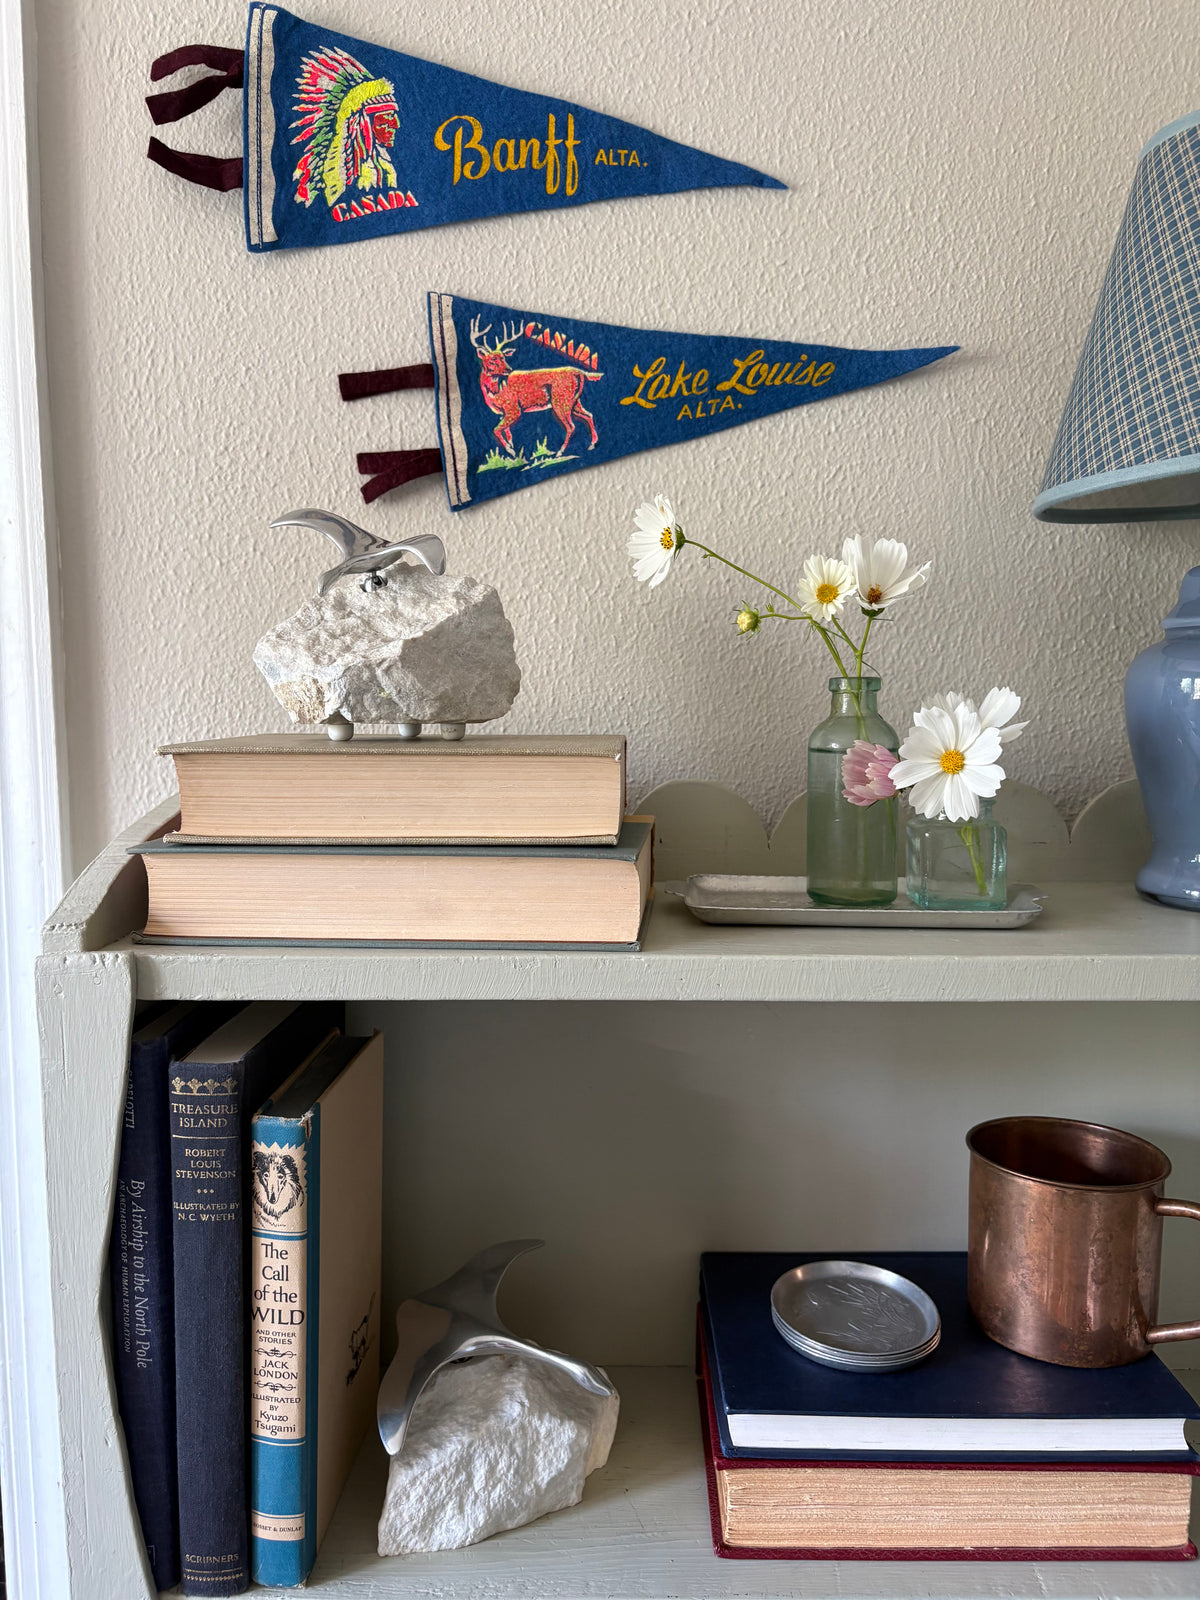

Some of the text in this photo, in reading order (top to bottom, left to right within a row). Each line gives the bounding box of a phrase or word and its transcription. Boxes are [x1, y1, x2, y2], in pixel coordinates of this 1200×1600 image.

[433, 112, 648, 196] Banff ALTA.
[332, 190, 419, 222] CANADA
[525, 321, 598, 371] CANADA
[619, 349, 835, 409] Lake Louise
[677, 395, 742, 420] ALTA.
[171, 1102, 238, 1115] TREASURE
[179, 1117, 228, 1129] ISLAND
[184, 1148, 226, 1158] ROBERT
[190, 1160, 222, 1169] LOUIS
[175, 1169, 236, 1179] STEVENSON
[173, 1201, 240, 1211] ILLUSTRATED BY
[200, 1213, 235, 1221] WYETH
[260, 1242, 289, 1260] The
[126, 1180, 153, 1368] By Airship to the North Pole
[262, 1265, 289, 1281] Call
[121, 1266, 129, 1297] HUMAN
[254, 1284, 297, 1303] of the
[251, 1306, 305, 1326] WILD
[122, 1298, 131, 1353] EXPLORATION
[259, 1336, 292, 1345] STORIES
[261, 1359, 289, 1369] JACK
[253, 1368, 298, 1380] LONDON
[252, 1393, 301, 1404] LLUSTRATED
[260, 1410, 288, 1422] Kyuzo
[254, 1420, 296, 1436] Tsugami
[185, 1553, 239, 1564] SCRIBNERS
